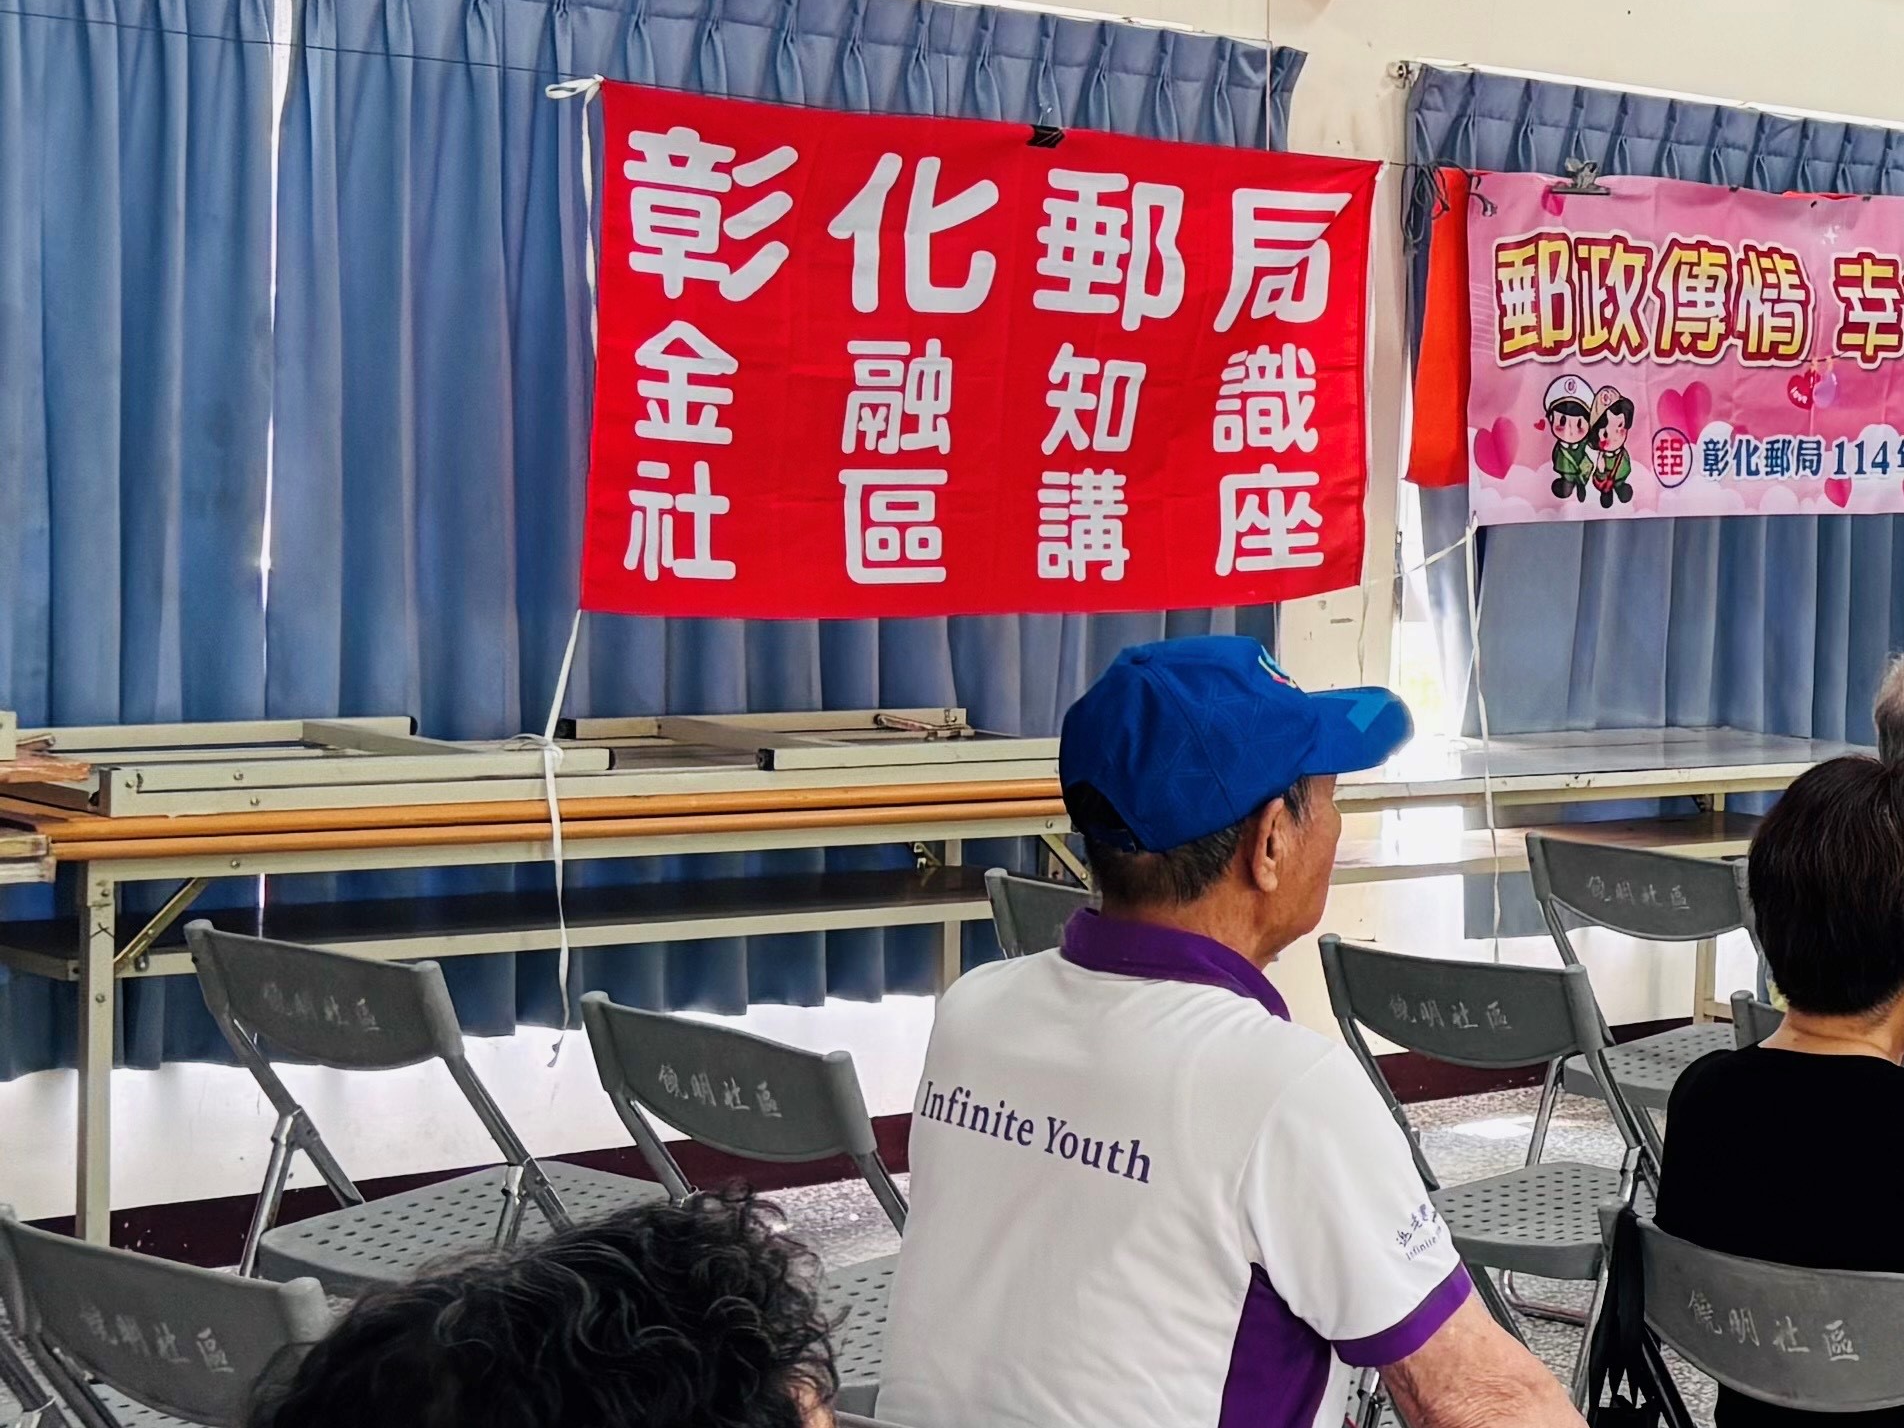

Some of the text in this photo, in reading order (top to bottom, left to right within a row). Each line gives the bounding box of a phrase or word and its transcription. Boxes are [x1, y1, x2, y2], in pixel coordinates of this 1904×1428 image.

[621, 125, 1353, 333] 彰化郵局
[1497, 232, 1814, 364] 郵政傳情
[633, 320, 1321, 455] 金融知識
[621, 459, 1327, 587] 社區講座
[920, 1079, 1153, 1185] Infinite Youth
